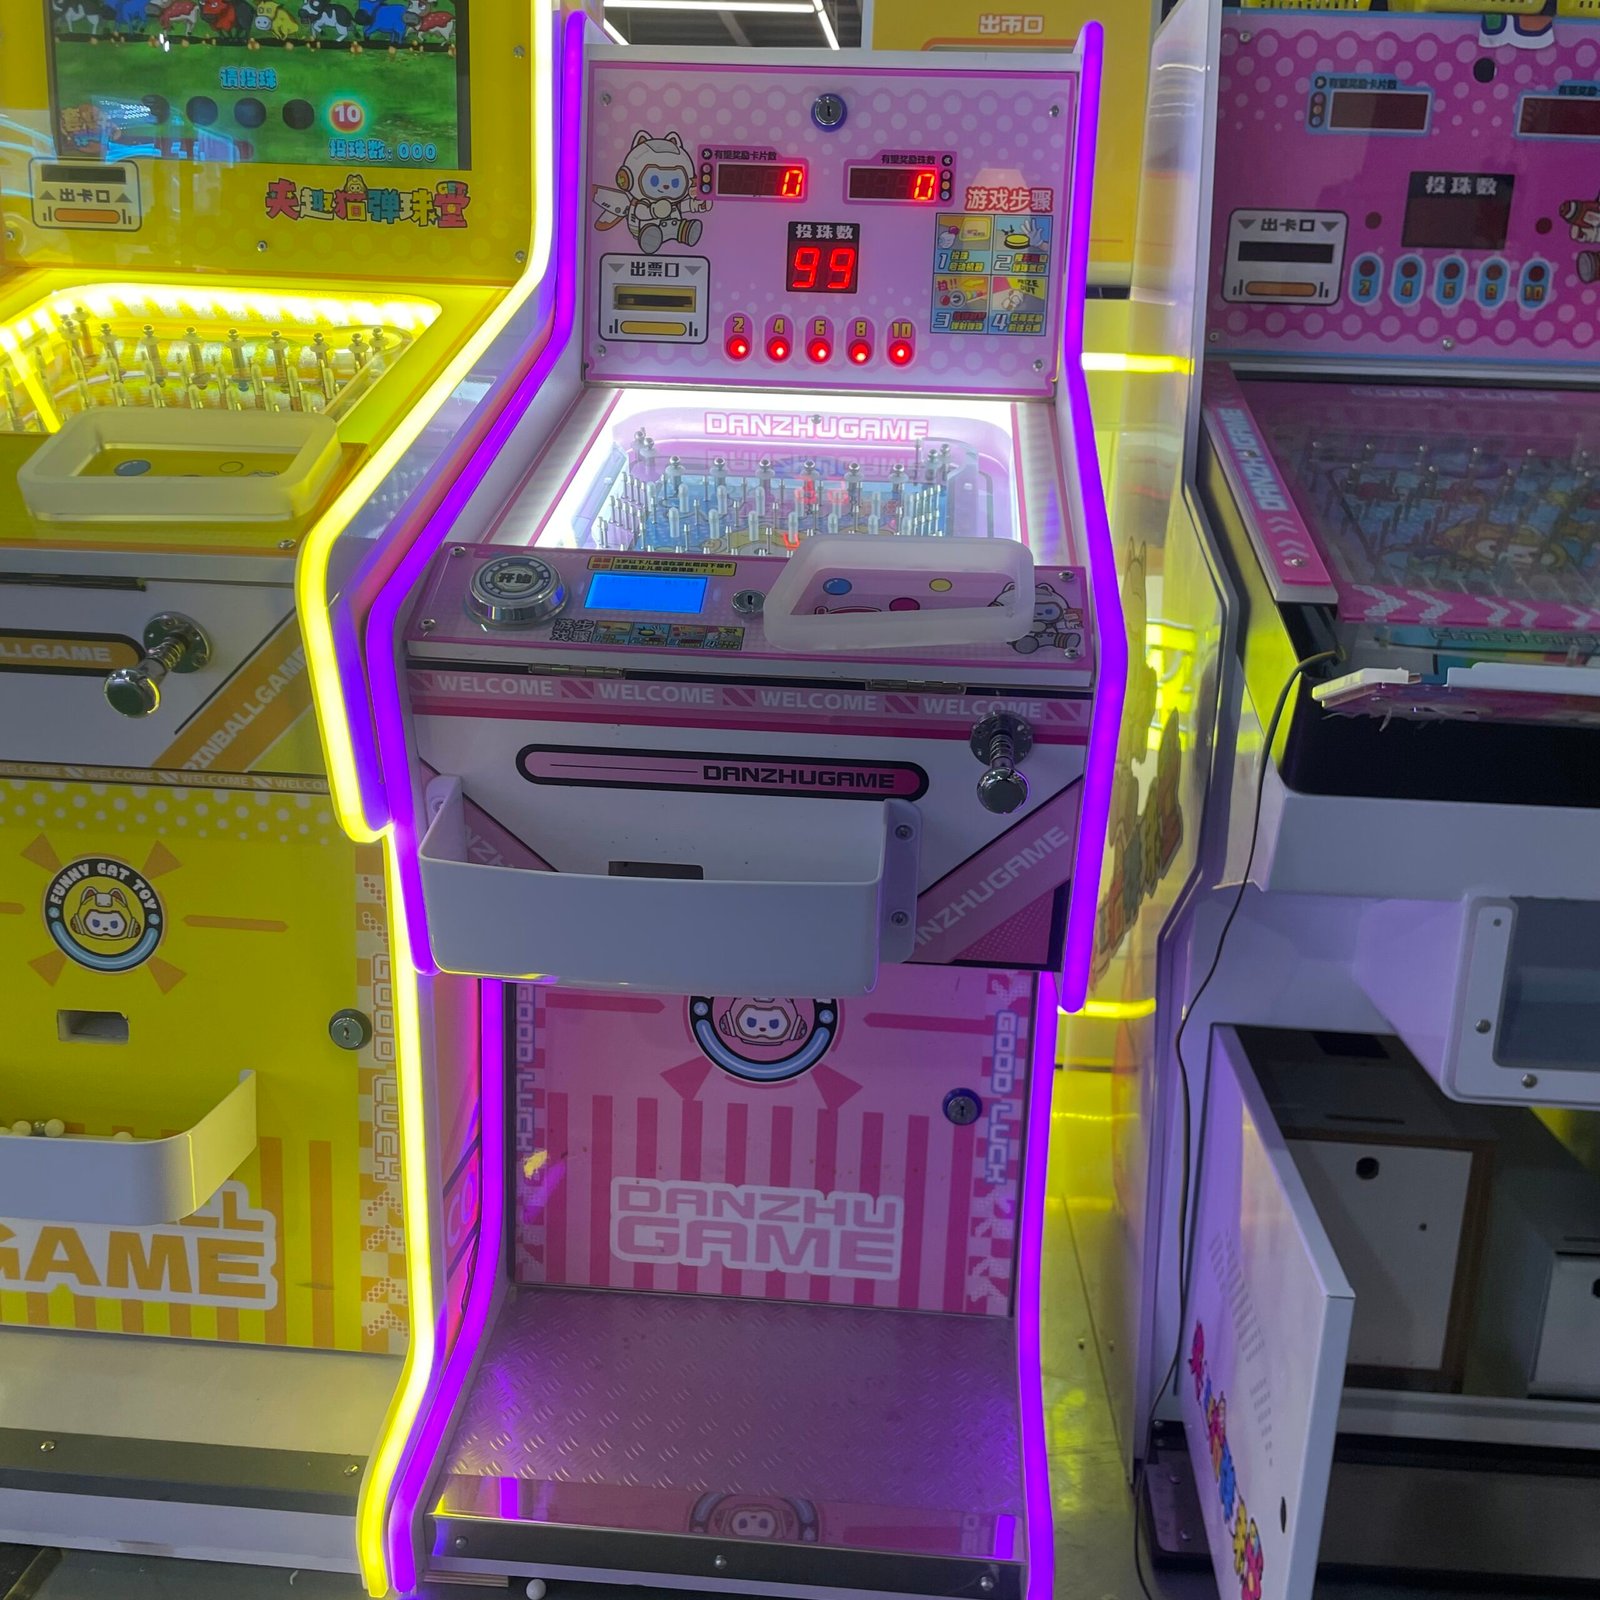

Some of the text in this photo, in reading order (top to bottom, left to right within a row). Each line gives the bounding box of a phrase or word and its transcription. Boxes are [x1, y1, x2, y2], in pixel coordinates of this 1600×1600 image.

[979, 14, 1044, 34] 出币口
[219, 67, 278, 90] 请投珠
[334, 105, 361, 123] 10
[782, 169, 803, 198] 0
[913, 172, 935, 201] 0
[1425, 176, 1498, 196] 投珠数
[59, 187, 111, 204] 出卡口
[966, 187, 1053, 212] 游戏步骤
[795, 224, 854, 241] 投珠数
[1260, 218, 1316, 233] 出卡口
[629, 261, 680, 278] 出票口
[791, 246, 856, 290] 99
[994, 255, 1012, 271] 2
[1358, 280, 1370, 296] 2
[1401, 282, 1413, 298] 4
[733, 316, 912, 339] 2 4 6 8 10
[933, 312, 950, 329] 3
[992, 313, 1008, 331] 4
[705, 412, 929, 441] DANZHUGAME
[437, 674, 1042, 720] WELCOME WELCOME WELCOME WELCOME
[182, 771, 249, 786] WELCOME
[702, 765, 895, 790] DANZHUGAME
[49, 862, 158, 910] FUNNY CAT TOY
[917, 825, 1071, 946] NZHUGAME
[373, 953, 396, 1062] GOOD
[990, 1010, 1018, 1094] GOOD
[617, 1184, 897, 1230] DANZHU
[616, 1216, 895, 1275] GAME
